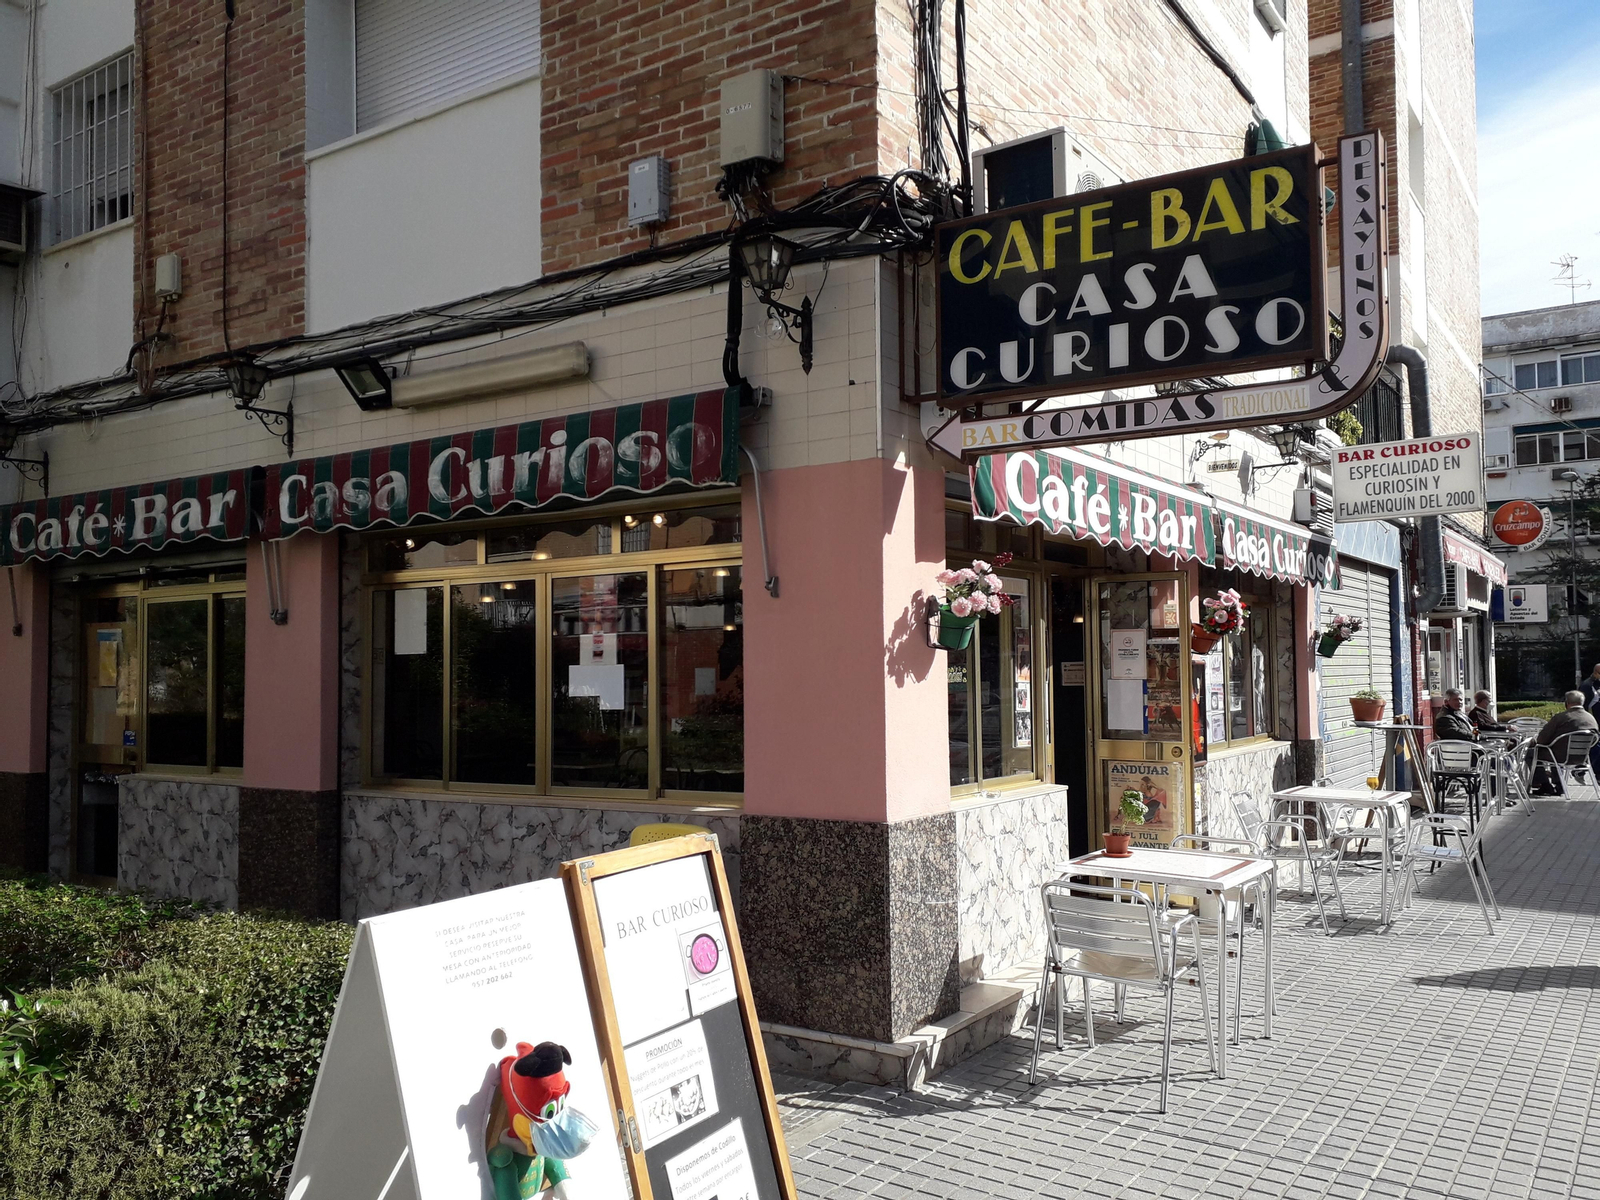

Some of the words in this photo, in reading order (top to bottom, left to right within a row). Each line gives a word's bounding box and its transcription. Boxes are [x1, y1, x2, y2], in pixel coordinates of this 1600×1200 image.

[948, 166, 1300, 284] CAFE-BAR
[1353, 139, 1376, 340] DESAYUNOS
[1018, 254, 1218, 326] CASA
[949, 297, 1305, 389] CURIOSO
[963, 422, 1021, 448] BAR
[1023, 393, 1216, 439] COMIDAS
[1223, 387, 1311, 418] TRADICIONAL
[1338, 449, 1375, 463] BAR
[1380, 438, 1471, 458] CURIOSO
[1350, 458, 1439, 480] ESPECIALIDAD
[1444, 455, 1460, 470] EN
[278, 470, 408, 525] Casa
[427, 422, 716, 504] Curioso
[1365, 475, 1428, 496] CURIOSÍN
[1433, 476, 1440, 489] Y
[9, 503, 109, 553] Café
[130, 488, 237, 540] Bar
[1006, 452, 1111, 534] Café
[1131, 492, 1197, 549] Bar
[1340, 494, 1415, 516] FLAMENQUÍN
[1420, 494, 1442, 509] DEL
[1446, 491, 1475, 506] 2000
[1495, 521, 1540, 531] Cruzcampo
[1223, 518, 1270, 568] Casa
[1273, 534, 1334, 581] Curioso
[1523, 543, 1536, 551] BAR
[617, 916, 647, 939] BAR
[652, 896, 708, 927] CURIOSO
[464, 957, 480, 966] CON
[486, 976, 499, 984] 202
[500, 971, 513, 980] 662
[645, 1038, 682, 1059] PROMOCIÓN
[676, 1151, 711, 1176] Disponemos
[711, 1147, 718, 1155] de
[718, 1135, 736, 1150] Codillo
[676, 1181, 692, 1194] Todos
[692, 1176, 701, 1184] los
